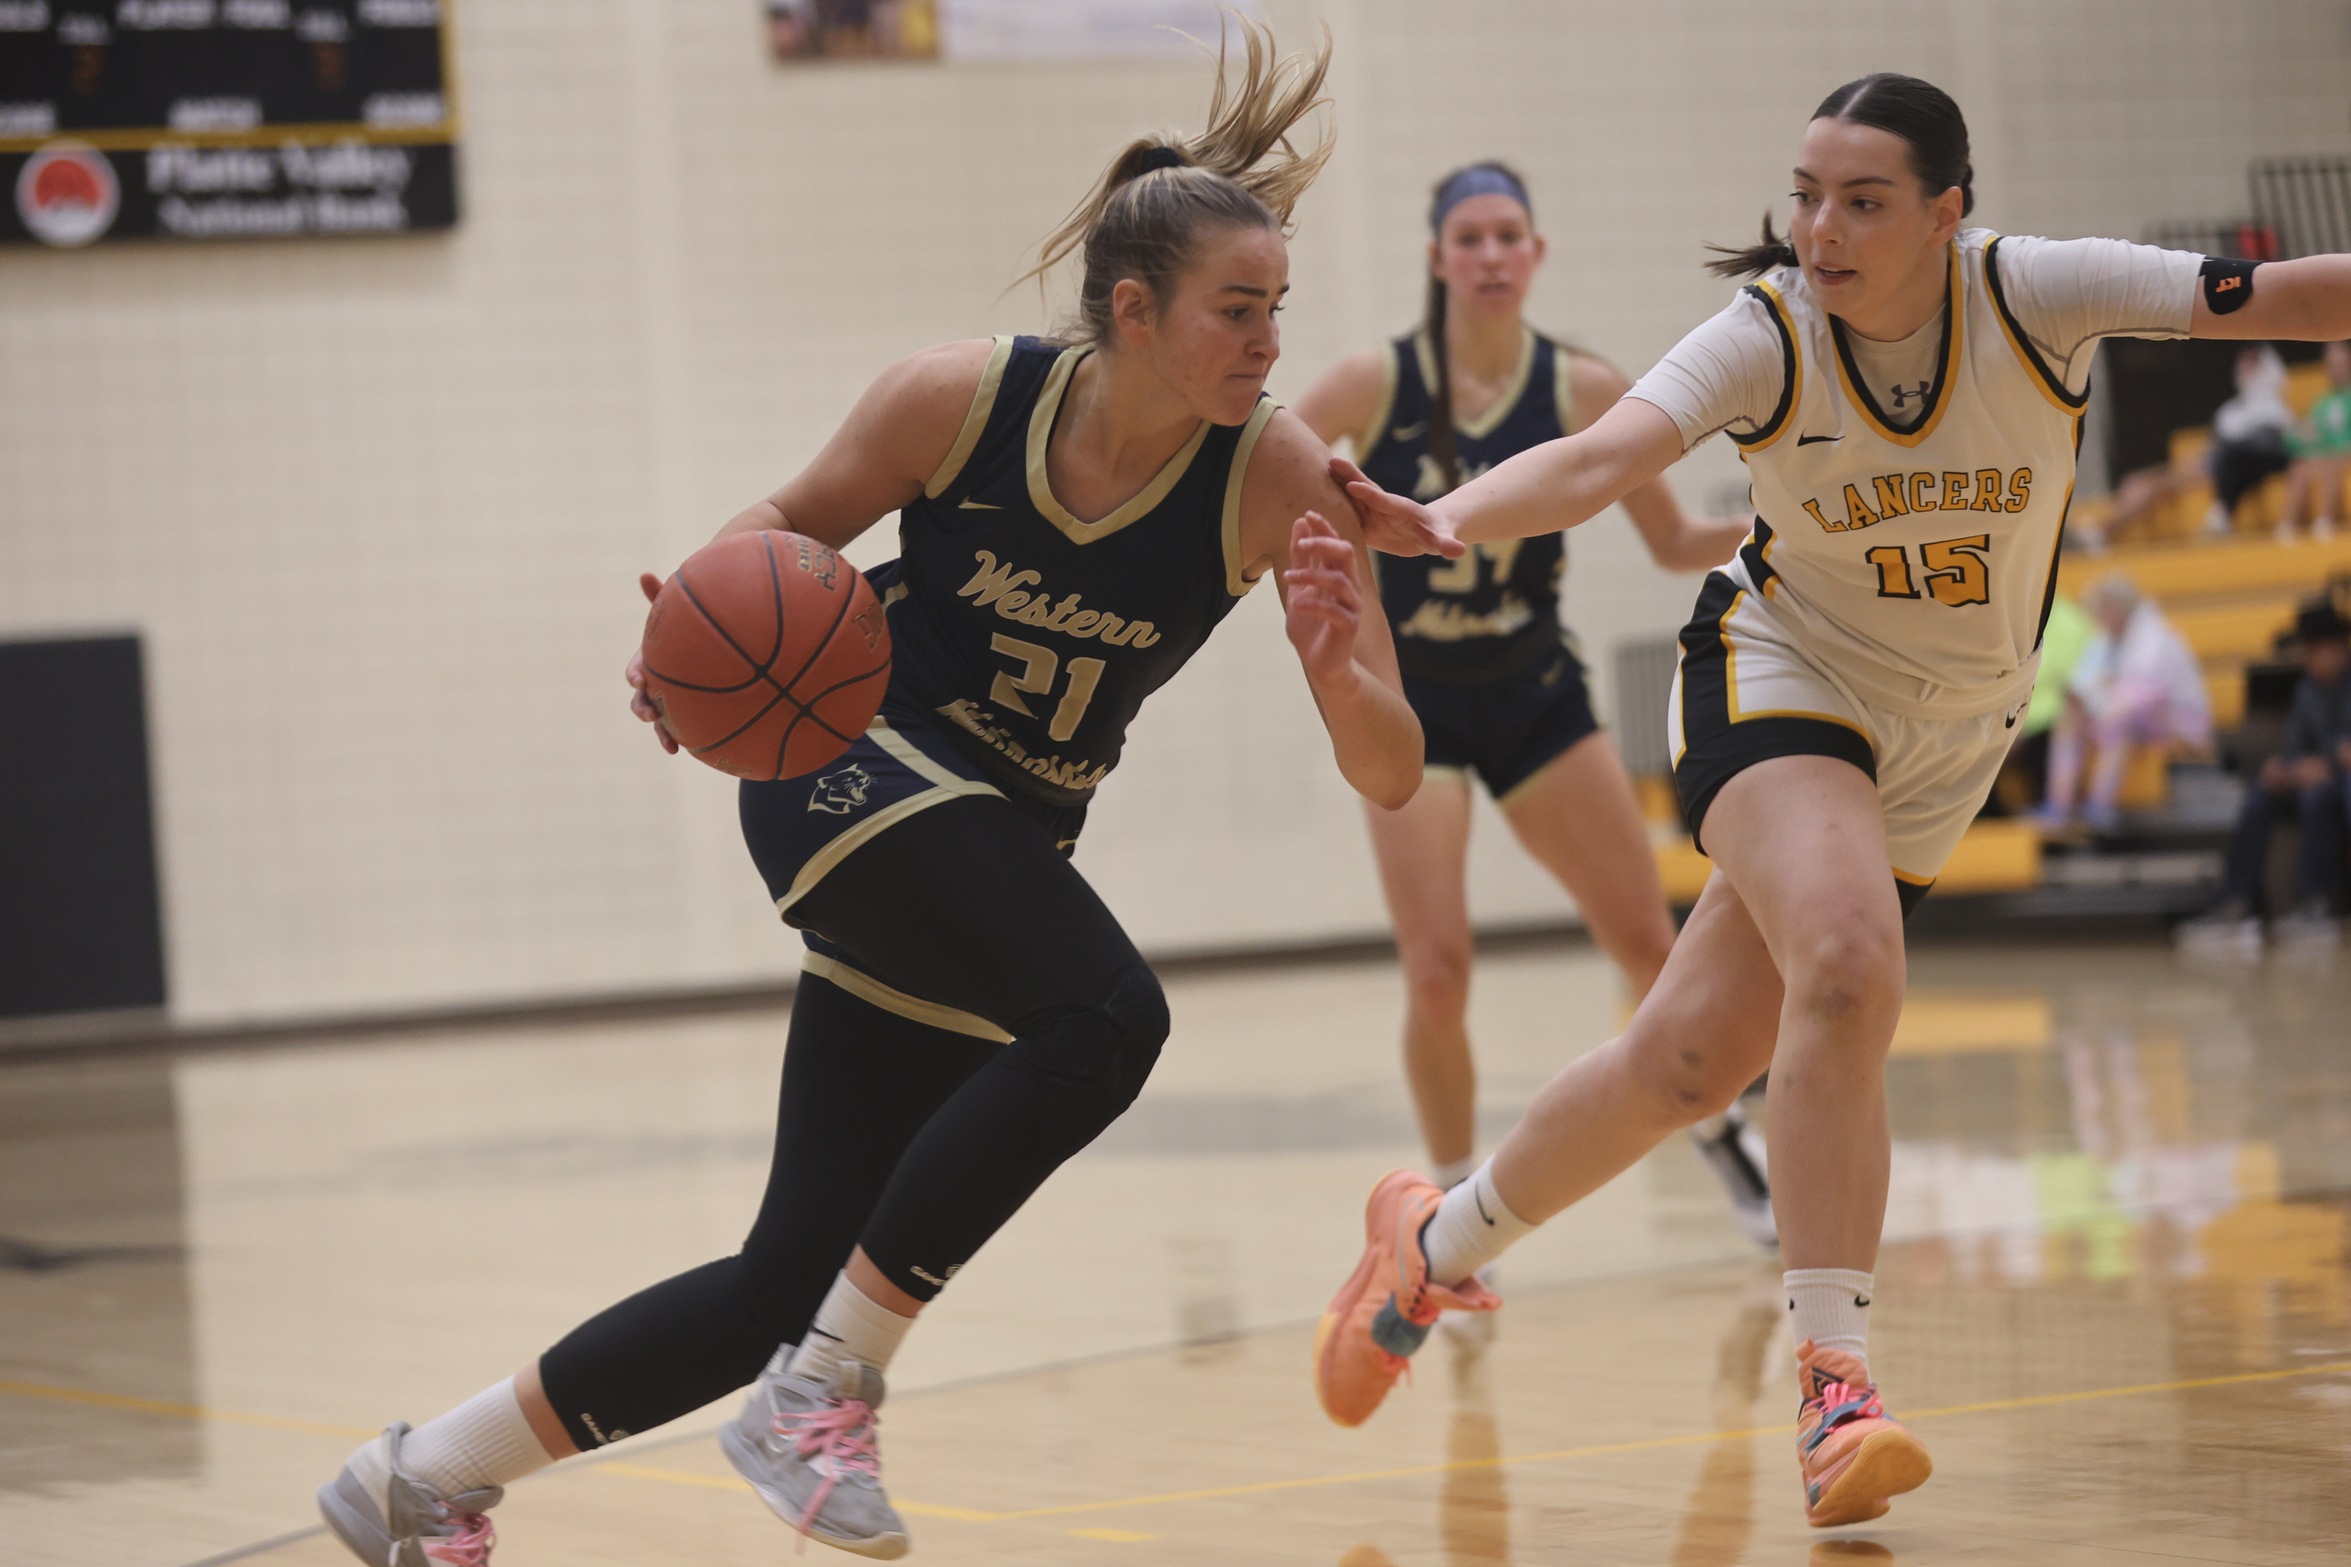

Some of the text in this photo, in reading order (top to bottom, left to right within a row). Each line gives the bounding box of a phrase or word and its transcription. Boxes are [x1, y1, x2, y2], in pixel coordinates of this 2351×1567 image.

[1802, 467, 2032, 533] LANCERS
[957, 550, 1161, 648] Western
[1865, 534, 1990, 608] 15
[989, 632, 1106, 741] 21
